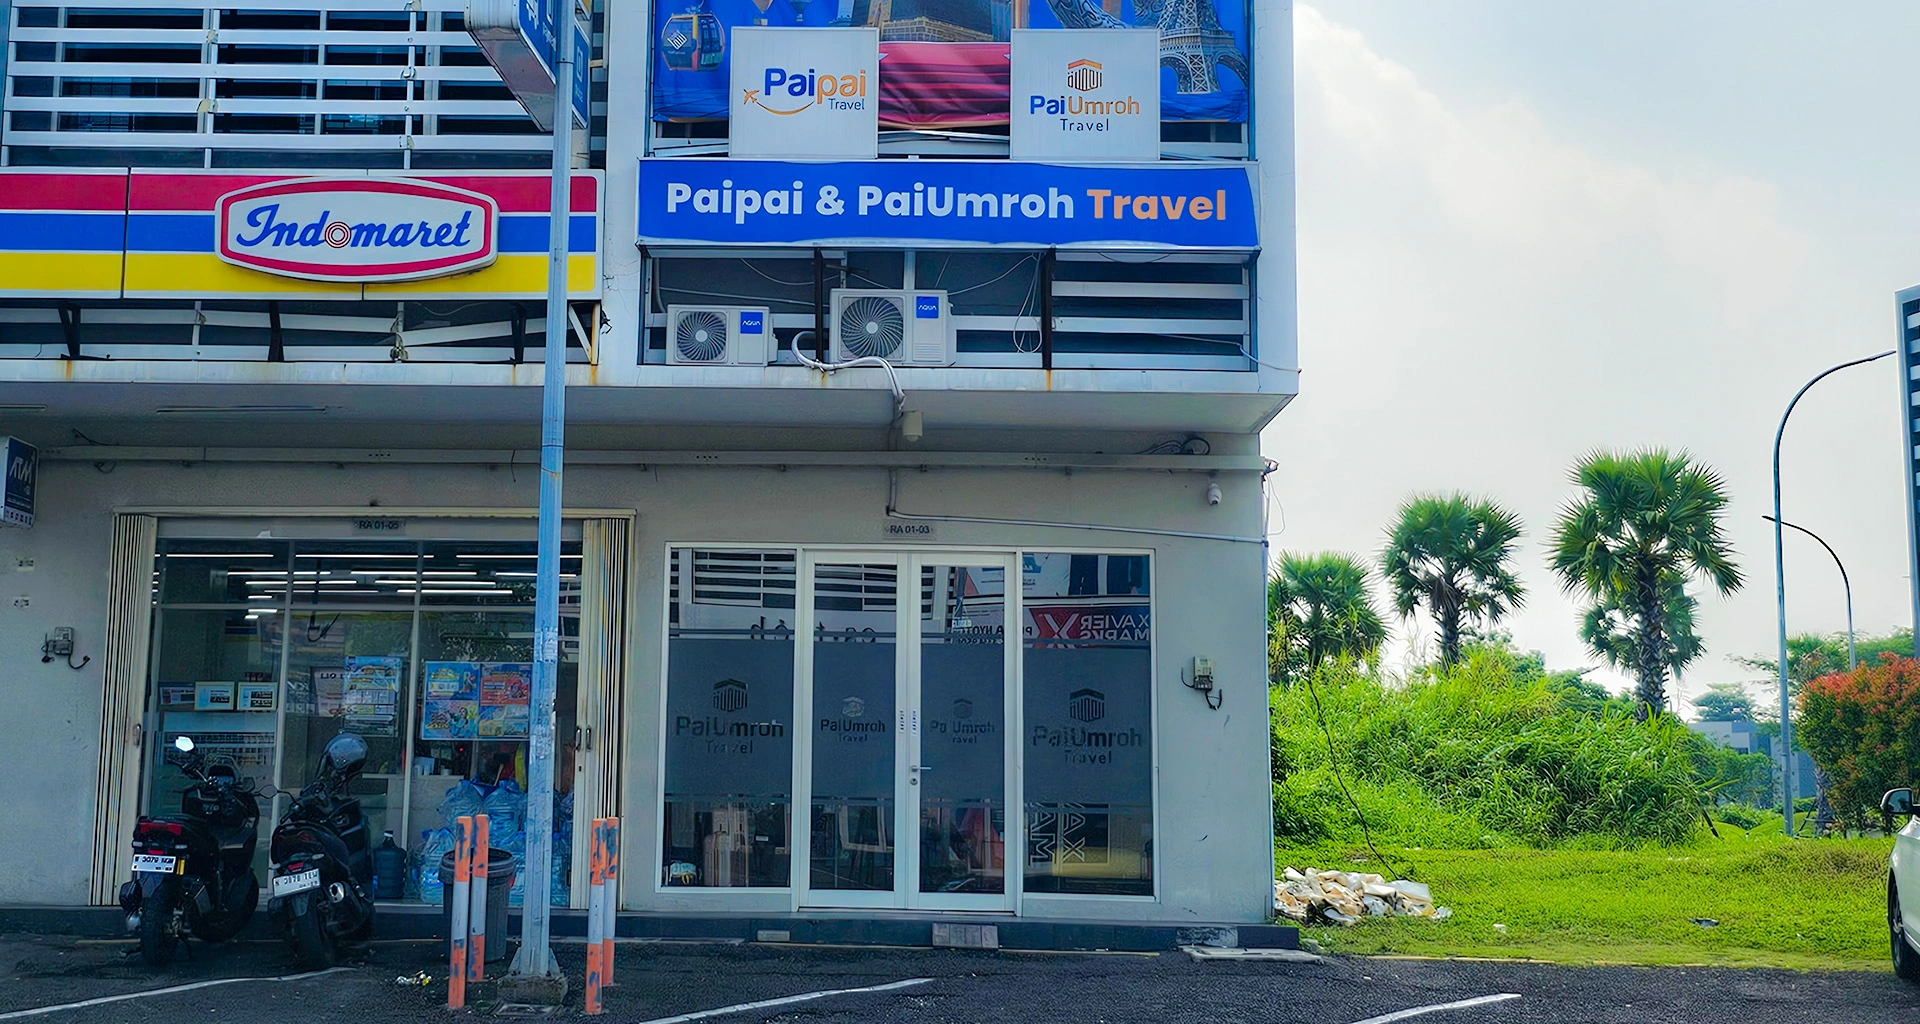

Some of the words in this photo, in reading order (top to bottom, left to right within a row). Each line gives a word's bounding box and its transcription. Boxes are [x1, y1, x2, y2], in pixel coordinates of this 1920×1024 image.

[764, 68, 866, 104] Paipai
[828, 98, 865, 110] Travel
[1029, 95, 1140, 115] PaiUmroh
[1060, 118, 1109, 131] Travel
[667, 179, 803, 224] Paipai
[815, 185, 845, 215] &
[858, 182, 1074, 218] PaiUmroh
[1087, 189, 1226, 220] Travel
[236, 203, 472, 248] Indomaret
[918, 304, 937, 312] AQUA
[742, 319, 761, 327] AQUA
[359, 519, 373, 530] RA
[890, 525, 904, 534] RA
[904, 525, 931, 534] 01-03
[675, 716, 784, 738] PaiUmroh
[820, 719, 886, 733] PaiUmroh
[1032, 725, 1142, 747] PaiUmroh
